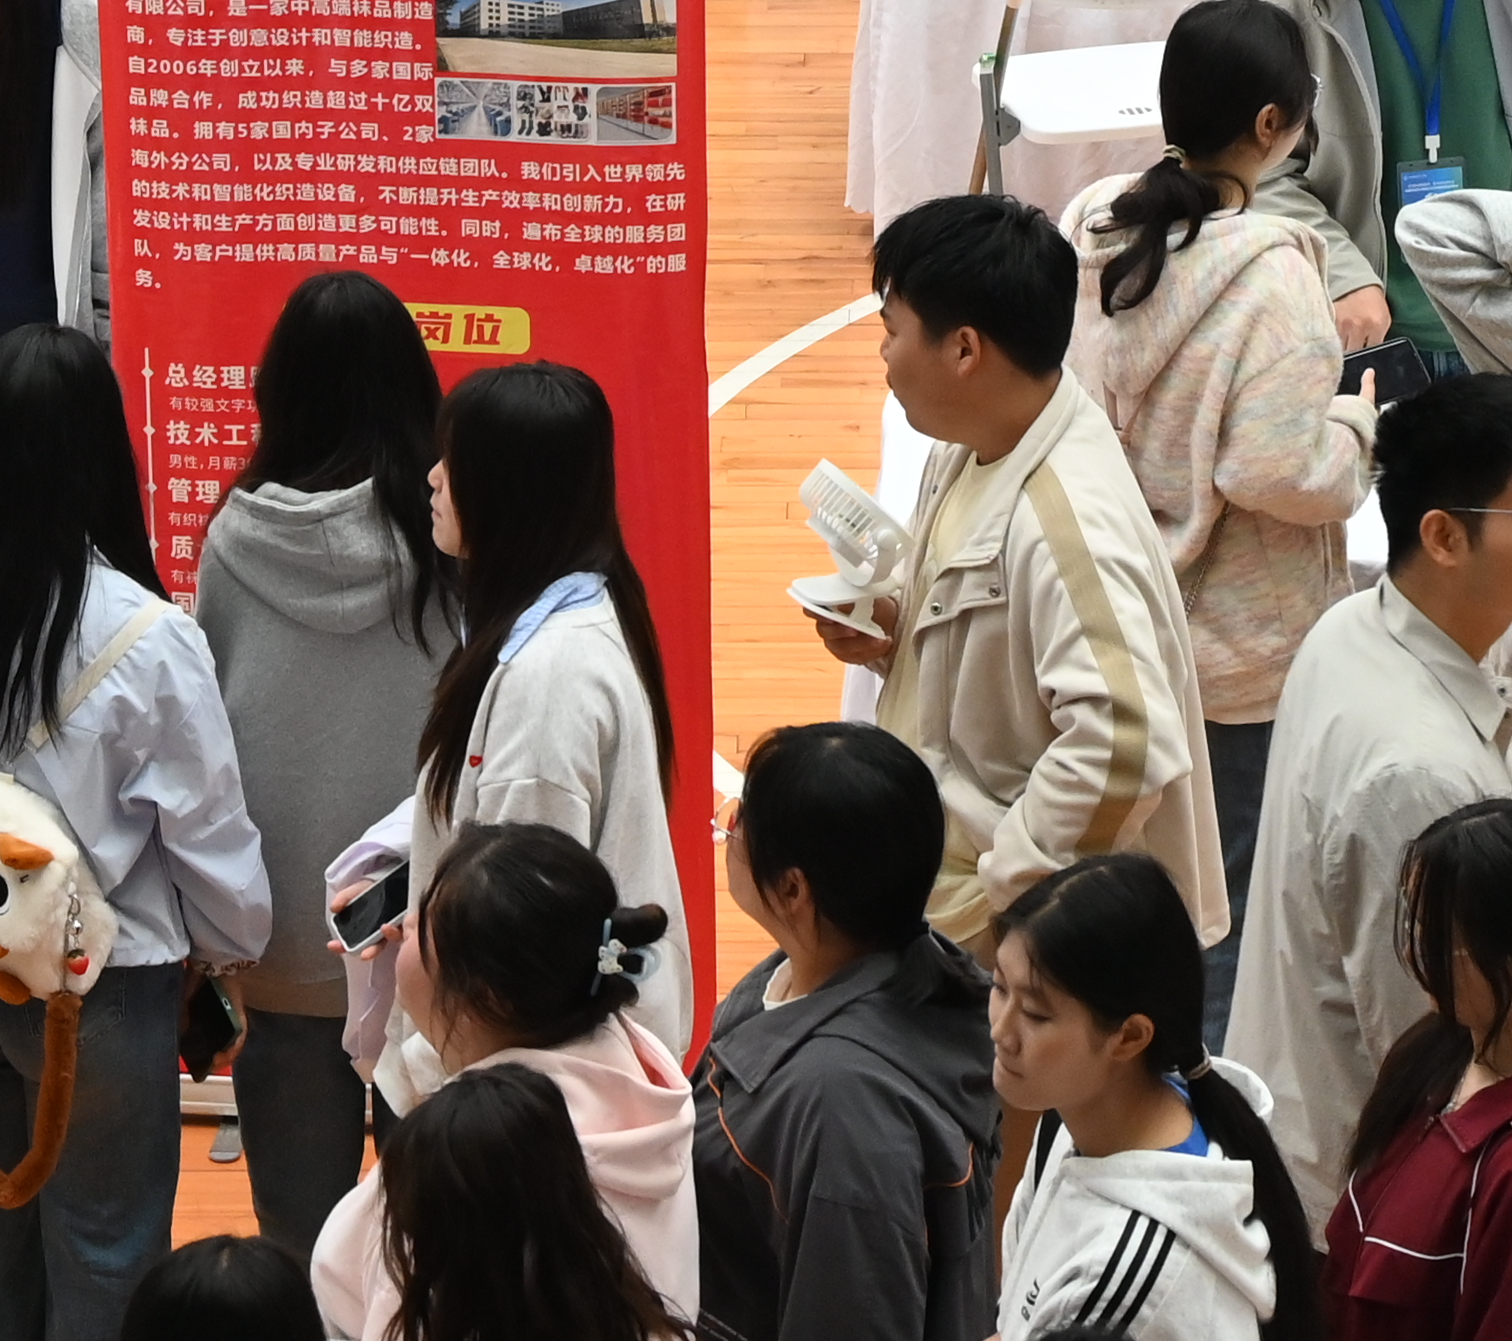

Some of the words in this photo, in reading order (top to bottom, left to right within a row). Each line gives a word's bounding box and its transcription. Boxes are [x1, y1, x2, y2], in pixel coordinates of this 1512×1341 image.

[125, 24, 422, 52] 商，专注于创意设计和智能织造。
[127, 55, 433, 81] 自2006年创立以来，与多家国际
[128, 87, 433, 113] 品牌合作，成功织造超过十亿双
[129, 117, 435, 144] 袜品。拥有5家国内子公司、2家
